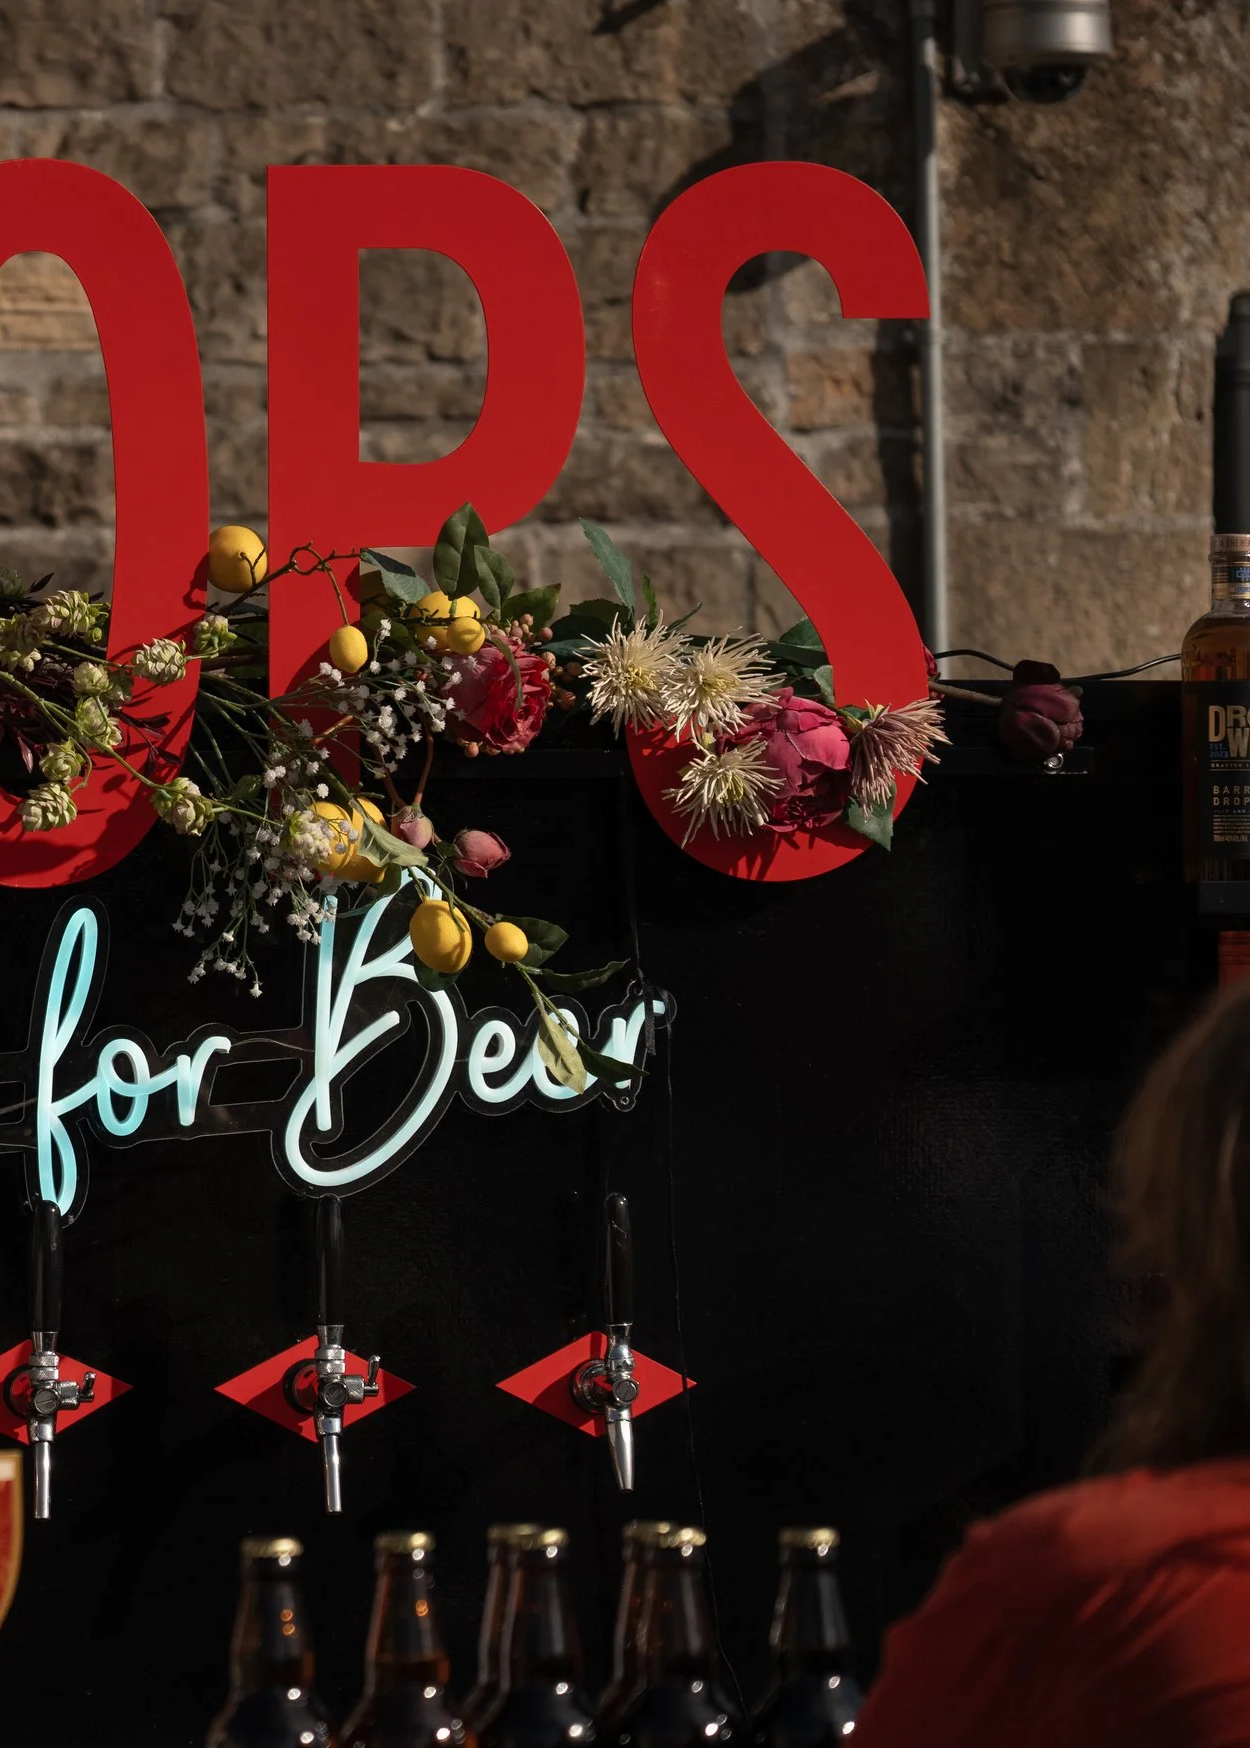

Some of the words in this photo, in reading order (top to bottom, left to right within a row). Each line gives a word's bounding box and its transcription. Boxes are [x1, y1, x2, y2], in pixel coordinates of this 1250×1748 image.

[1209, 705, 1250, 742] DR
[37, 907, 231, 1217] for
[284, 866, 666, 1187] Beer
